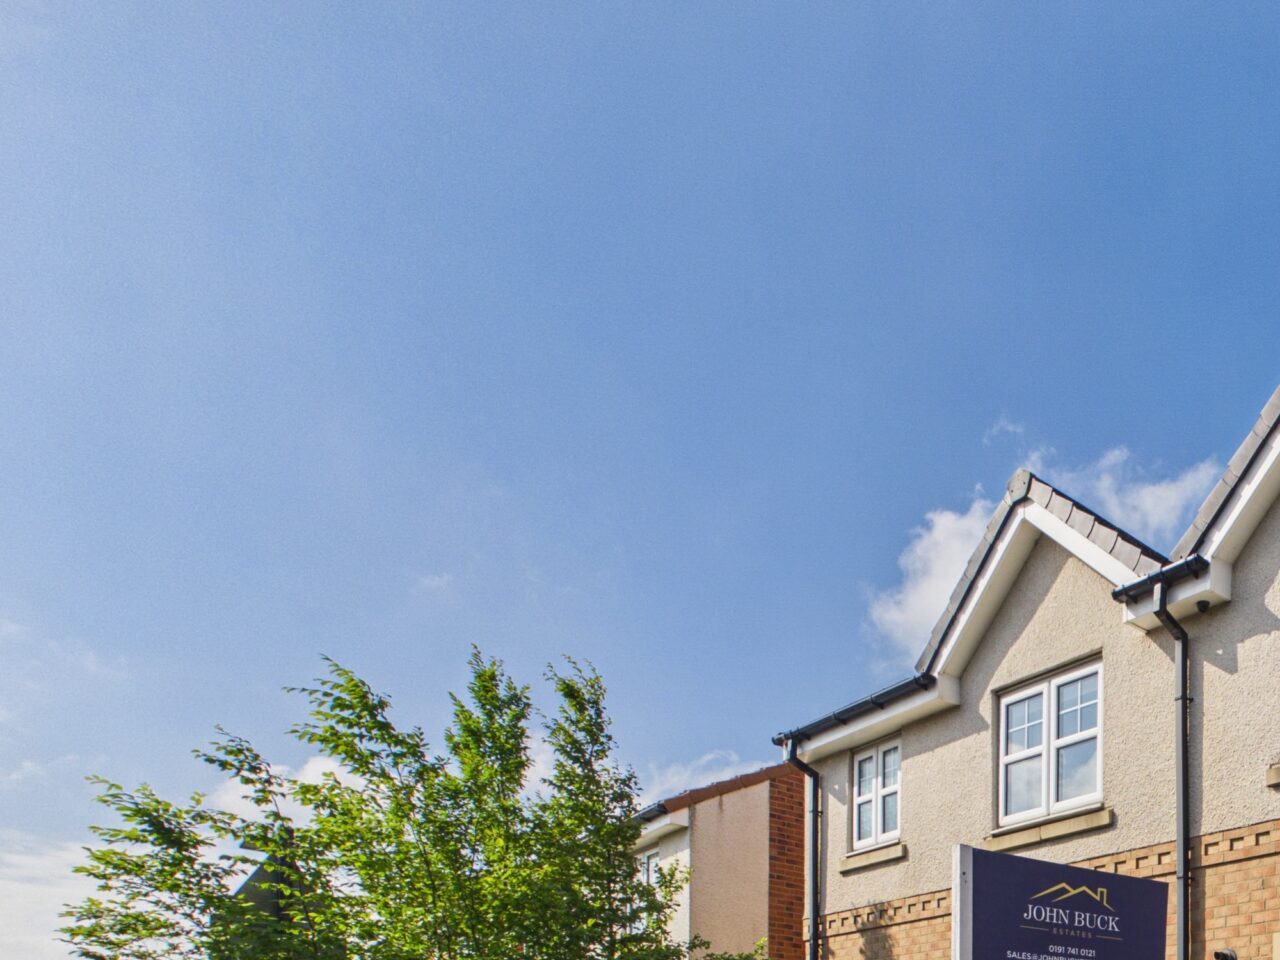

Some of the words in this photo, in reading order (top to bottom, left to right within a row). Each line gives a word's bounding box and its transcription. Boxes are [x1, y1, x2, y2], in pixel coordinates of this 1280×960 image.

[1023, 904, 1070, 925] JOHN
[1074, 911, 1120, 932] BUCK
[1053, 927, 1092, 938] ESTATES
[1048, 945, 1065, 955] 0191
[1067, 946, 1079, 956] 741
[1080, 948, 1096, 957] 0121
